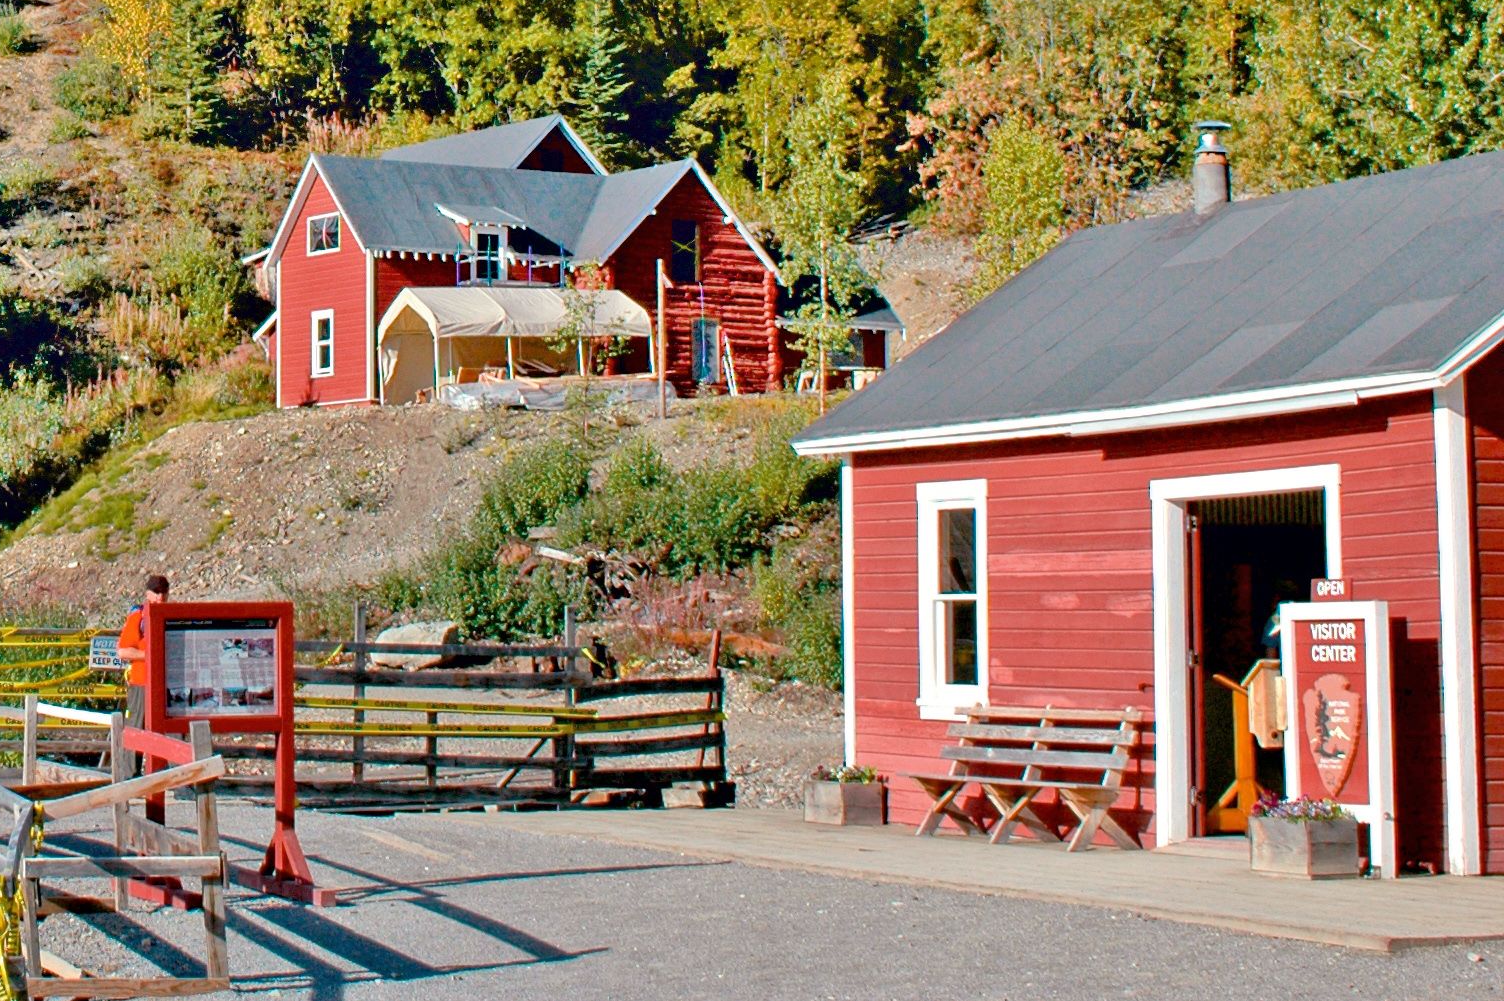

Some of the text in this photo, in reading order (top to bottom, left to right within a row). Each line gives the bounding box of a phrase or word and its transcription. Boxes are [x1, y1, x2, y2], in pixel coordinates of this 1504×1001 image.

[1316, 581, 1344, 596] OPEN
[1310, 622, 1356, 640] VISITOR
[24, 634, 62, 643] CAUTION
[1311, 645, 1356, 662] CENTER
[92, 657, 112, 665] KEEP
[57, 686, 95, 694] CAUTION
